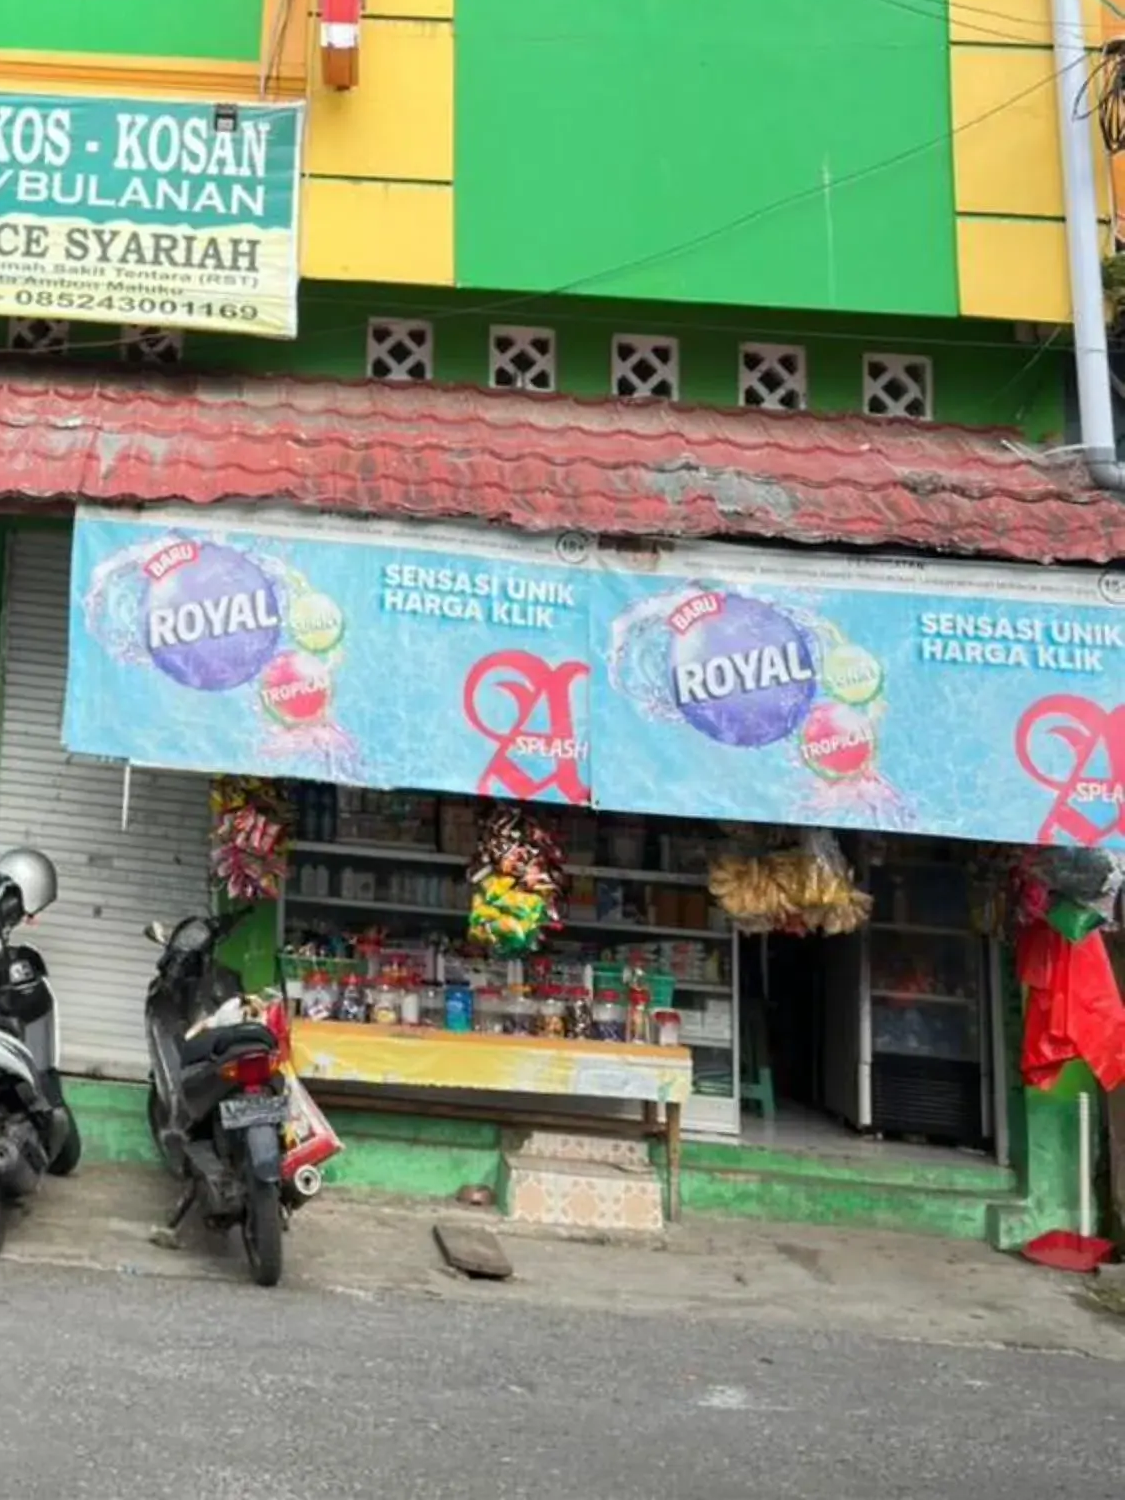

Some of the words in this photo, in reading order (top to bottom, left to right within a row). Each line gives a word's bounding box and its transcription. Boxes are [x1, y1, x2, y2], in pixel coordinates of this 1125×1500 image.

[113, 112, 272, 179] KOSAN
[64, 226, 262, 273] SYARIAH
[115, 266, 193, 284] Tentara
[14, 289, 259, 321] 085243001169
[148, 543, 196, 579] BARU
[384, 563, 499, 597] SENSASI
[506, 577, 576, 607] UNIK
[149, 588, 279, 650] ROYAL
[383, 587, 485, 622] HARGA
[491, 601, 555, 629] KLIK
[671, 594, 719, 630] BARU
[920, 611, 1043, 643] SENSASI
[1050, 620, 1125, 648] UNIK
[676, 640, 813, 705] ROYAL
[922, 636, 1030, 667] HARGA
[1037, 647, 1105, 672] KLIK
[515, 735, 590, 760] SPLASH
